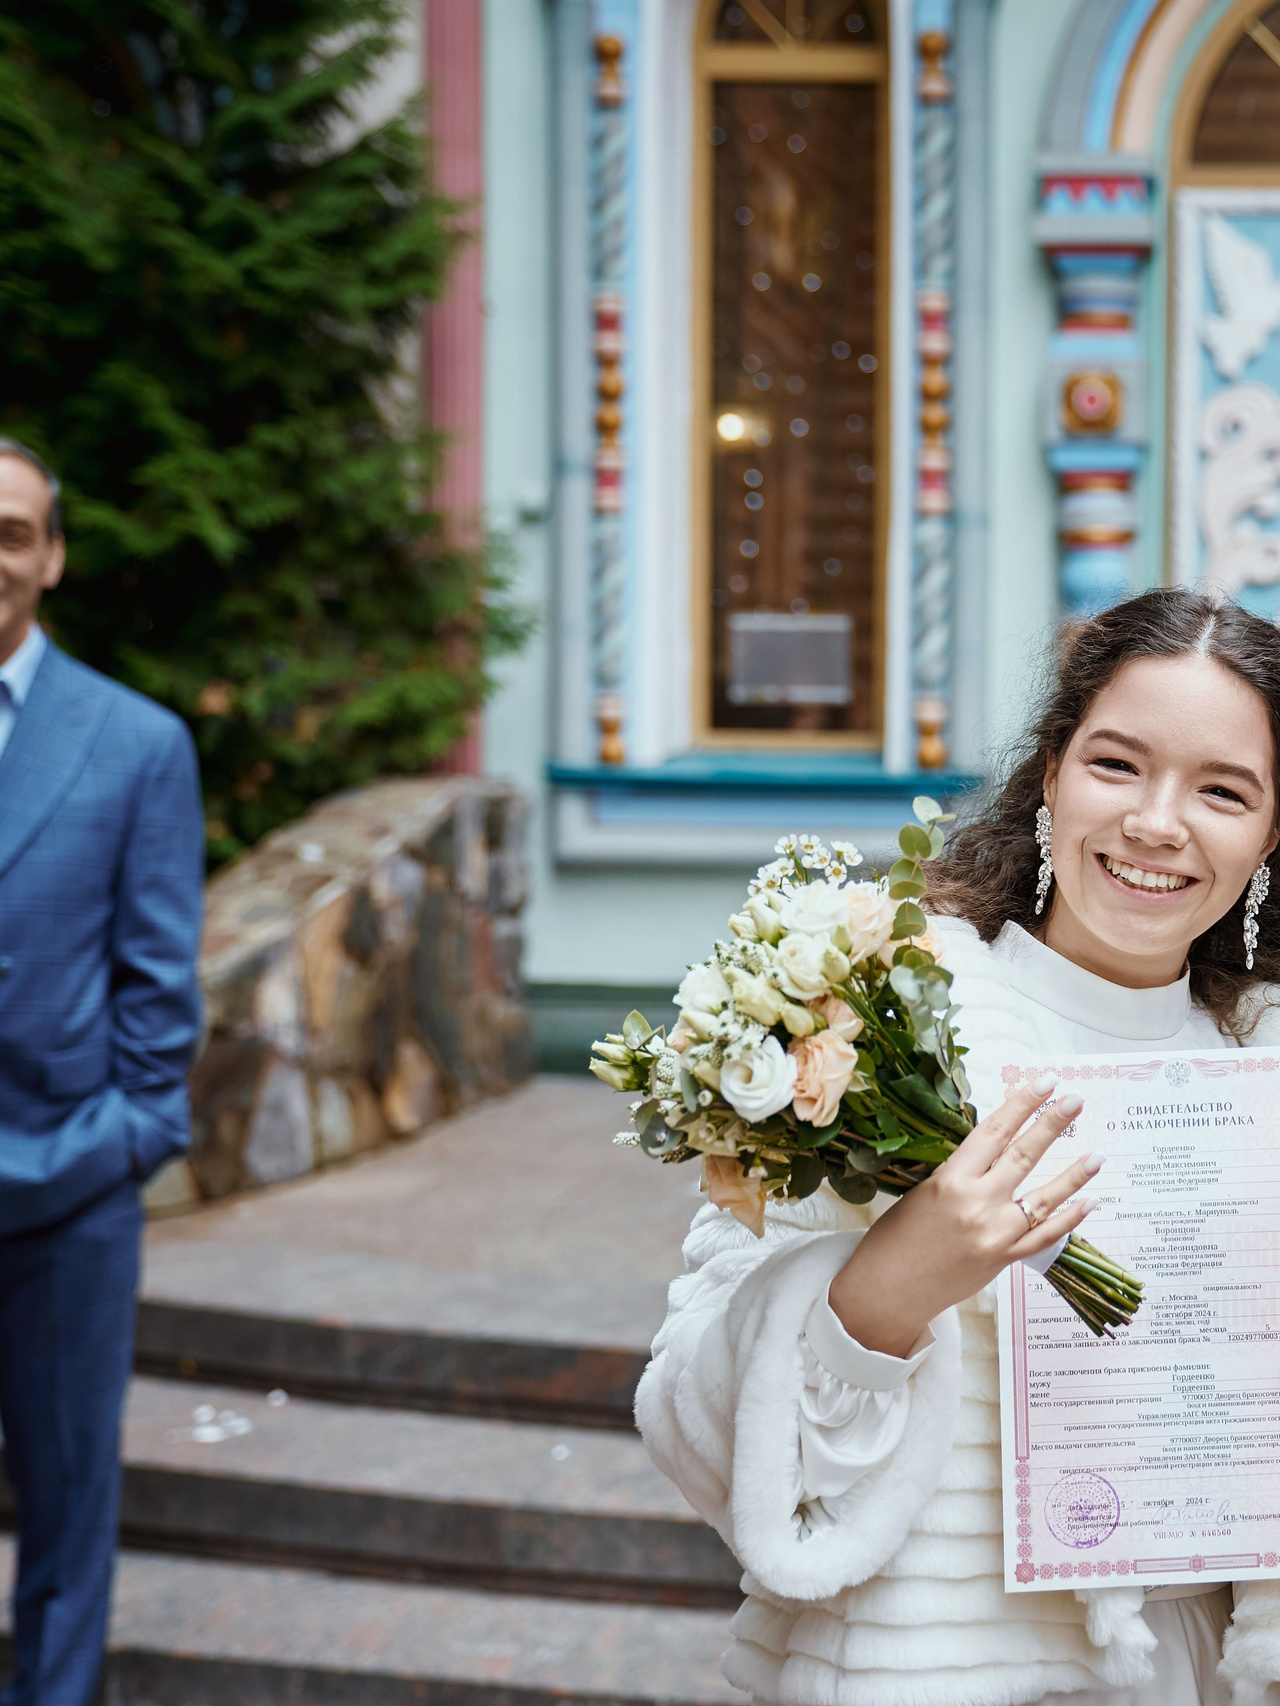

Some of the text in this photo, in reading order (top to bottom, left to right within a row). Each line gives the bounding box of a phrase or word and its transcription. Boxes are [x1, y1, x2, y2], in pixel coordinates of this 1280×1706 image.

[1127, 1102, 1233, 1116] СВИДЕТЕЛЬСТВО
[1107, 1115, 1255, 1131] О ЗАКЛЮЧЕНИИ БРАКА
[1152, 1145, 1195, 1153] Гордеенко
[1132, 1160, 1217, 1171] Эдуард Максимович
[1176, 1177, 1219, 1185] Федерация
[1114, 1211, 1152, 1221] Донецкая
[1153, 1209, 1186, 1218] область,
[1195, 1208, 1239, 1217] Мариуполь
[1148, 1218, 1170, 1226] (место
[1155, 1226, 1200, 1235] Воронцова
[1161, 1235, 1195, 1243] (фамилия)
[1138, 1244, 1218, 1253] Алина Леонидовна
[1135, 1260, 1222, 1270] Российская Федерация
[1161, 1310, 1192, 1318] октября
[1027, 1316, 1072, 1324] заключили
[1150, 1328, 1181, 1336] октября
[1199, 1326, 1227, 1334] месяца
[1128, 1338, 1177, 1346] заключении
[1178, 1336, 1201, 1344] брака
[1029, 1369, 1052, 1378] После
[1054, 1368, 1102, 1376] заключения
[1103, 1366, 1126, 1375] брака
[1128, 1365, 1171, 1374] присвоены
[1029, 1373, 1215, 1389] мужу Гордеенко
[1172, 1383, 1215, 1392] Гордеенко
[1053, 1398, 1114, 1408] государственной
[1115, 1396, 1161, 1405] регистрации
[1137, 1412, 1181, 1421] Управления
[1064, 1424, 1106, 1432] произведена
[1107, 1421, 1162, 1429] государственная
[1163, 1419, 1205, 1427] регистрация
[1221, 1416, 1266, 1424] гражданского
[1084, 1440, 1136, 1449] свидетельства
[1203, 1436, 1230, 1444] Дворец
[1139, 1455, 1183, 1463] Управления
[1184, 1453, 1202, 1461] ЗАГС
[1113, 1463, 1169, 1472] государственной
[1170, 1462, 1213, 1470] регистрации
[1229, 1458, 1275, 1467] гражданского
[1143, 1499, 1175, 1507] октября
[1186, 1497, 1203, 1505] 2024
[1202, 1529, 1232, 1537] 646560
